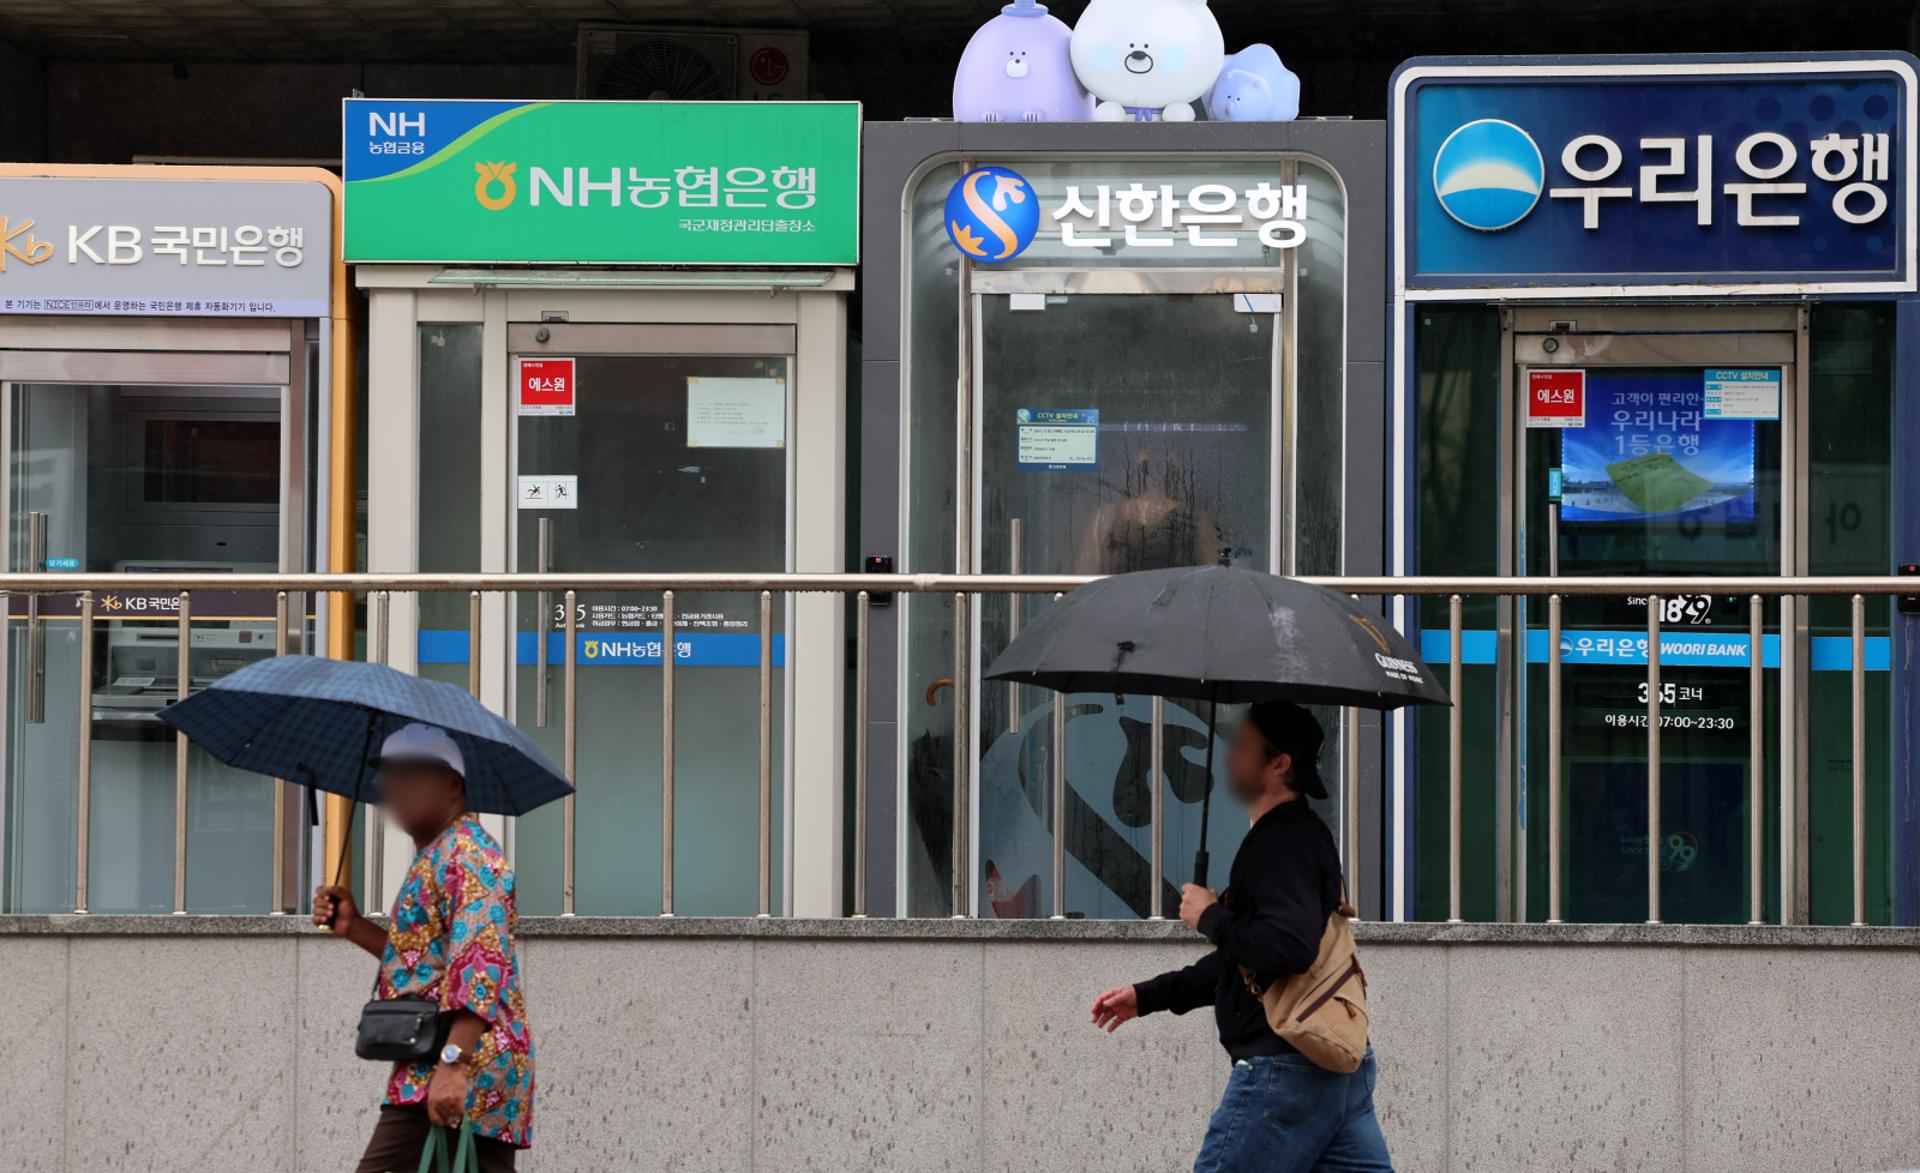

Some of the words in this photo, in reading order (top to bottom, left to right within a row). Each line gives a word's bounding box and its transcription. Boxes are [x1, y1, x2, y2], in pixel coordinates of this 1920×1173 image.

[369, 112, 425, 137] NH
[369, 141, 425, 155] 농협금융
[529, 166, 817, 210] NH농협은행
[1550, 132, 1889, 229] 우리은행
[1052, 183, 1308, 249] 신한은행
[678, 219, 817, 232] 국군재정관리단출장소
[5, 299, 14, 309] 본
[17, 299, 41, 310] 기기는
[114, 301, 147, 312] 운영하는
[150, 301, 182, 312] 국민은행
[186, 301, 202, 312] 제휴
[205, 302, 246, 313] 자동화기기
[1716, 371, 1738, 380] CCTV
[528, 377, 566, 392] 에스원
[1536, 388, 1575, 404] 에스원
[1611, 392, 1654, 406] 고객이
[1658, 392, 1700, 406] 편리한
[1610, 410, 1702, 432] 우리나라
[554, 604, 586, 621] 35
[601, 642, 692, 658] NH농협행
[1660, 642, 1705, 656] WOORI
[1707, 644, 1747, 657] BANK
[1678, 686, 1703, 701] 코너
